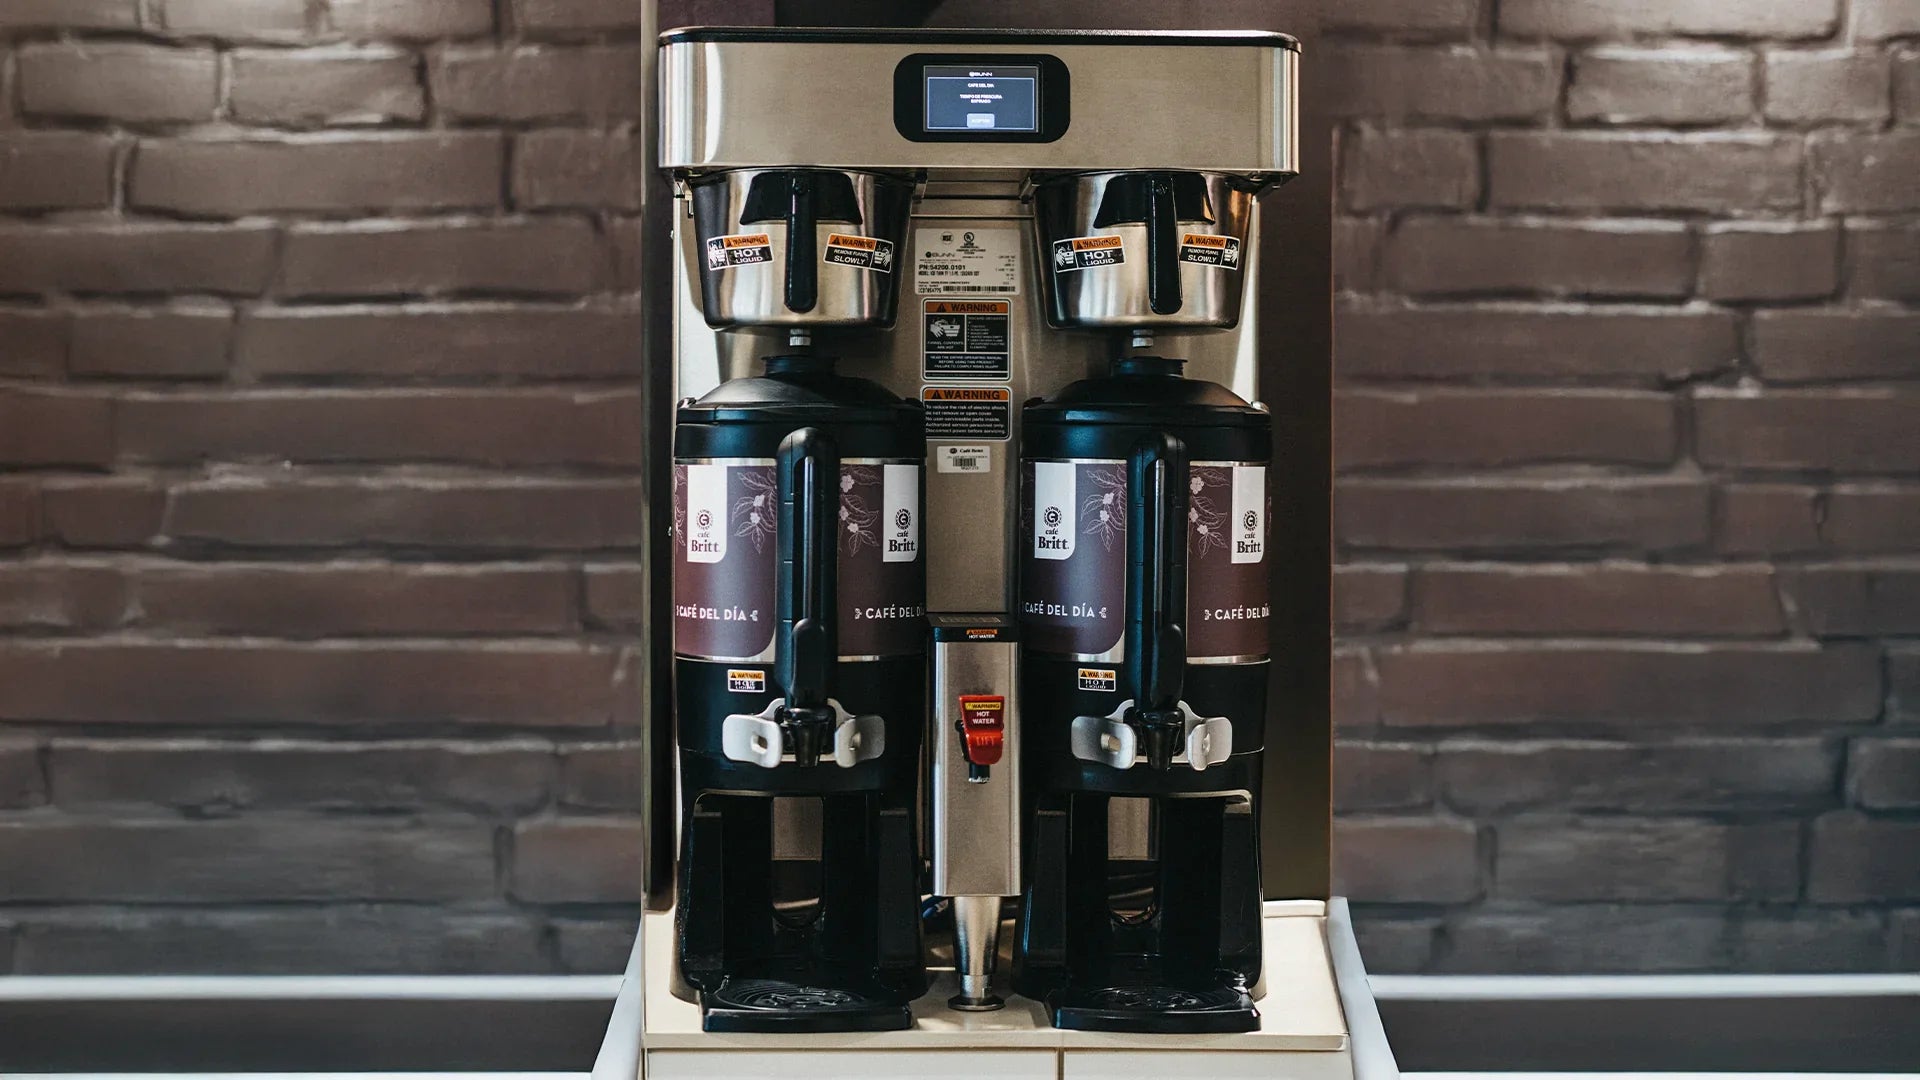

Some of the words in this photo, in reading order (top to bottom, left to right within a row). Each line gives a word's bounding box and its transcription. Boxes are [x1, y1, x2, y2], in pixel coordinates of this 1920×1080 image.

[732, 236, 765, 246] WARNING
[842, 238, 873, 249] WARNING
[1082, 238, 1118, 248] WARNING
[1195, 238, 1224, 247] WARNING
[734, 248, 761, 258] HOT
[1084, 250, 1113, 260] HOT
[834, 255, 866, 264] SLOWLY
[1086, 258, 1115, 266] LIQUID
[1188, 255, 1217, 263] SLOWLY
[951, 304, 997, 312] WARNING
[944, 391, 1000, 400] WARNING
[691, 540, 719, 552] Britt
[888, 538, 915, 552] Britt
[1038, 536, 1068, 549] Britt
[1237, 540, 1261, 553] Britt
[680, 604, 697, 618] CAFÉ
[699, 608, 720, 620] DEL
[724, 606, 746, 621] DÍA
[866, 604, 896, 619] CAFÉ
[899, 607, 914, 618] DEL
[1025, 600, 1044, 614] CAFÉ
[1047, 604, 1068, 616] DEL
[1073, 603, 1095, 617] DÍA
[1214, 604, 1244, 620] CAFÉ
[1246, 608, 1261, 619] DEL
[1262, 603, 1270, 617] DÍA
[976, 736, 994, 746] LIFT
